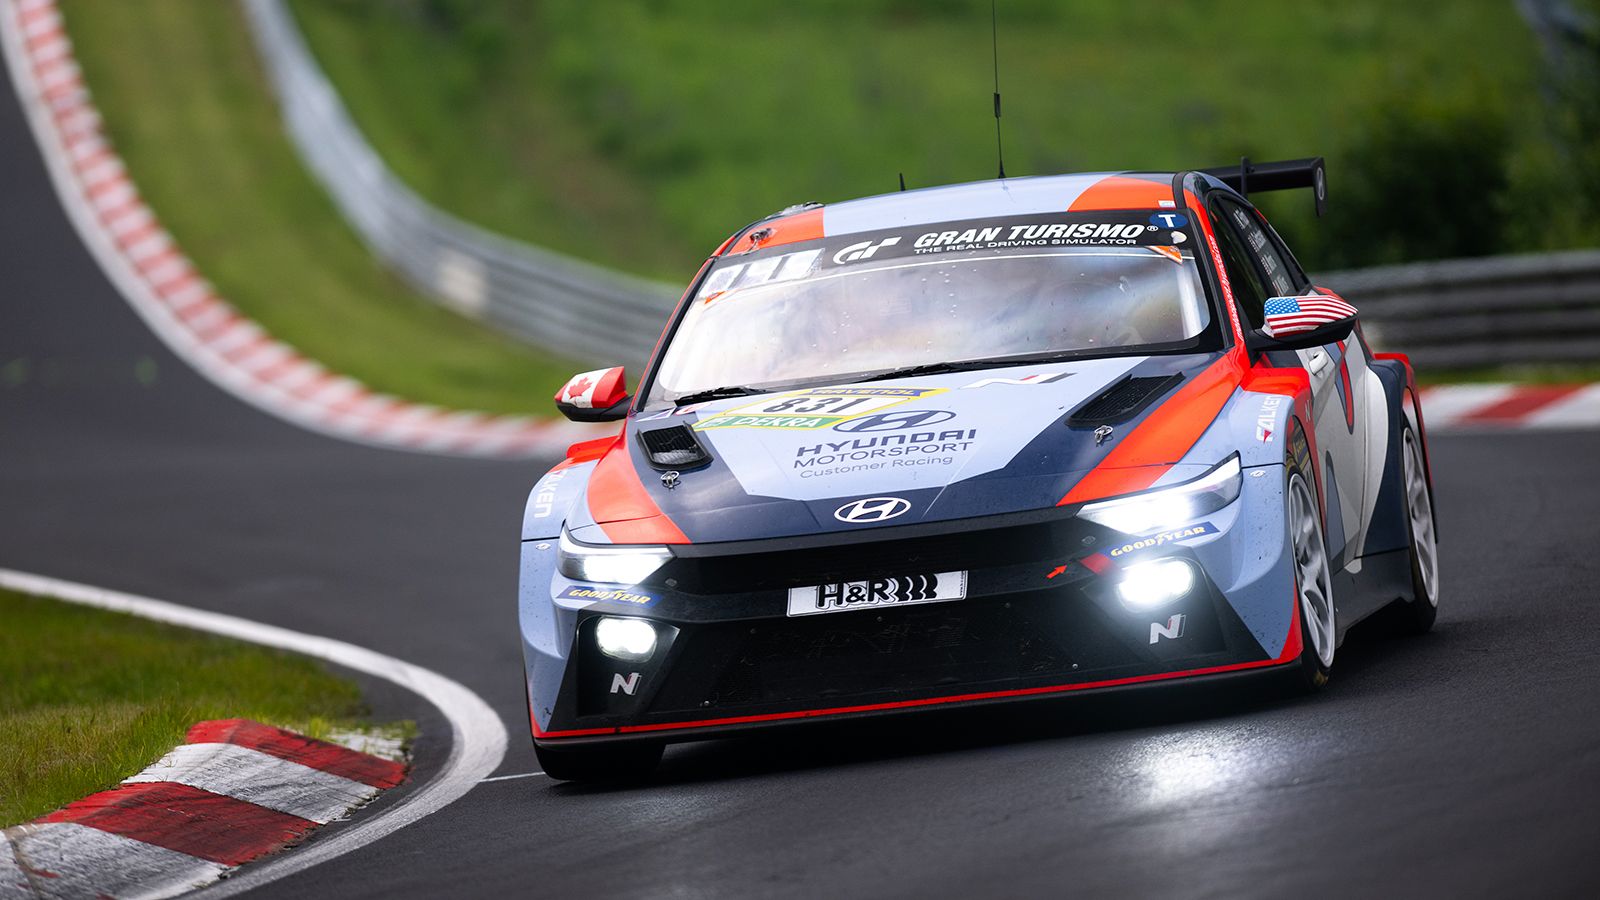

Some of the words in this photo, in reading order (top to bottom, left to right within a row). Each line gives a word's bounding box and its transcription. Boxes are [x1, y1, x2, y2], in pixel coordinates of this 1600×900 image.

[1158, 214, 1176, 228] T
[913, 226, 1003, 248] GRAN
[914, 246, 942, 254] THE
[946, 243, 984, 252] REAL
[987, 239, 1047, 249] DRIVING
[763, 397, 872, 413] 831
[731, 416, 822, 428] DEKRA
[797, 429, 977, 457] HYUNDAI
[793, 442, 974, 469] MOTORSPORT
[800, 462, 885, 478] Customer
[892, 456, 953, 468] Racing
[1110, 526, 1206, 557] GOODYEAR
[568, 589, 652, 604] GOODYEAR
